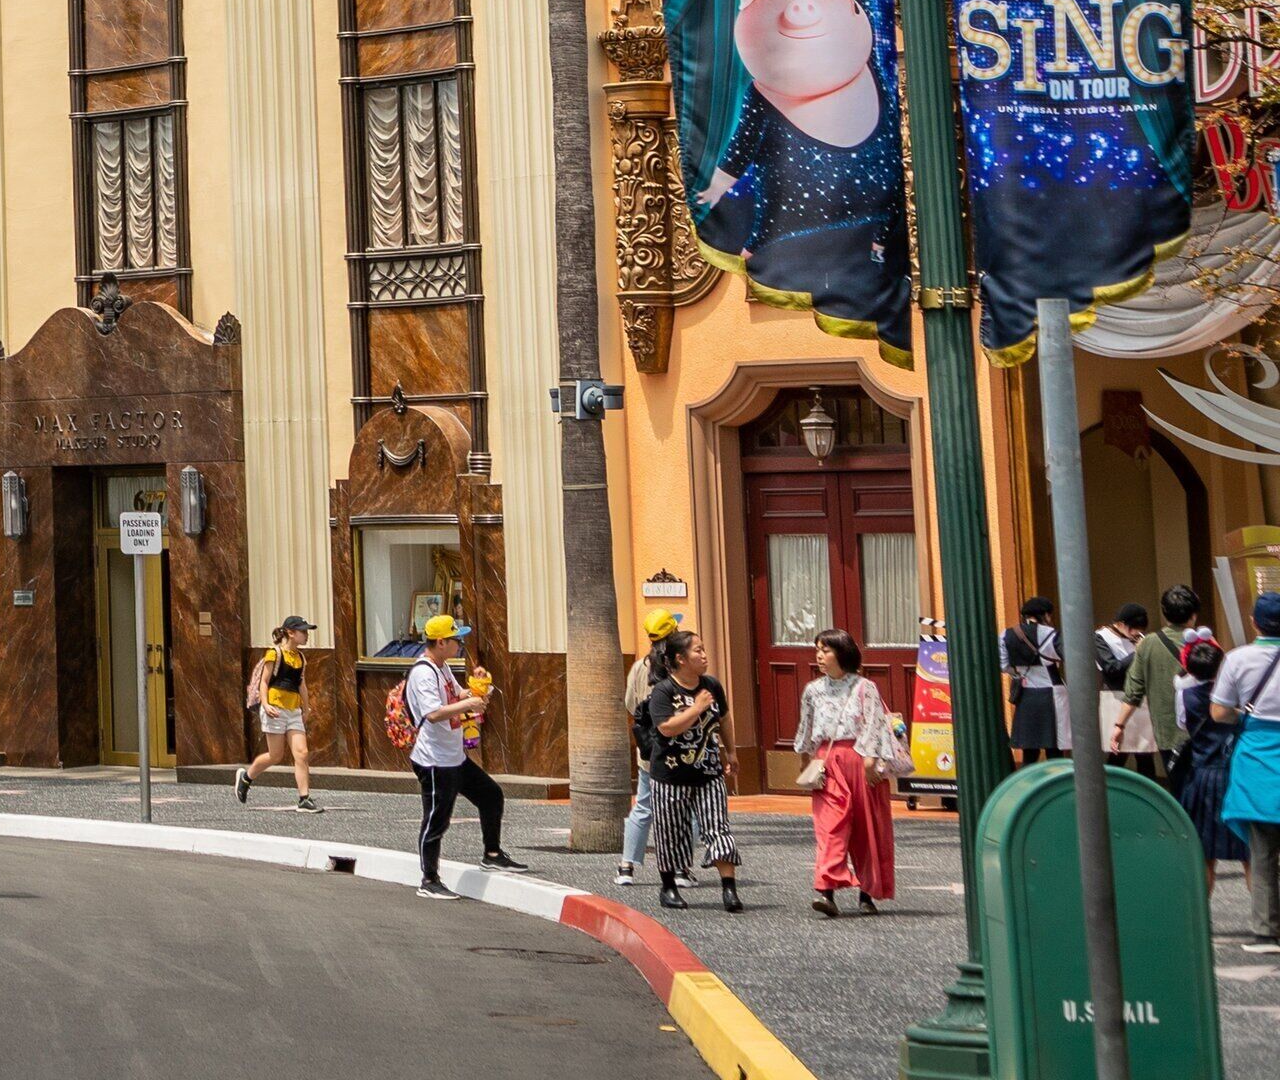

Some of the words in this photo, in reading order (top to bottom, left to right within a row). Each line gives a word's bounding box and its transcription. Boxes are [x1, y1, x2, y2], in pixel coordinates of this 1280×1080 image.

[1050, 81, 1075, 100] ON
[1080, 77, 1130, 99] TOUR
[1064, 105, 1114, 115] STUDIOS
[1119, 104, 1158, 113] JAPAN
[35, 413, 78, 434] MAX
[90, 410, 184, 431] FACTOR
[56, 436, 107, 451] MAKE-UP
[116, 433, 161, 449] STUDIO
[123, 520, 159, 528] PASSENGER
[128, 529, 154, 537] LOADING
[1122, 1001, 1159, 1024] AIL
